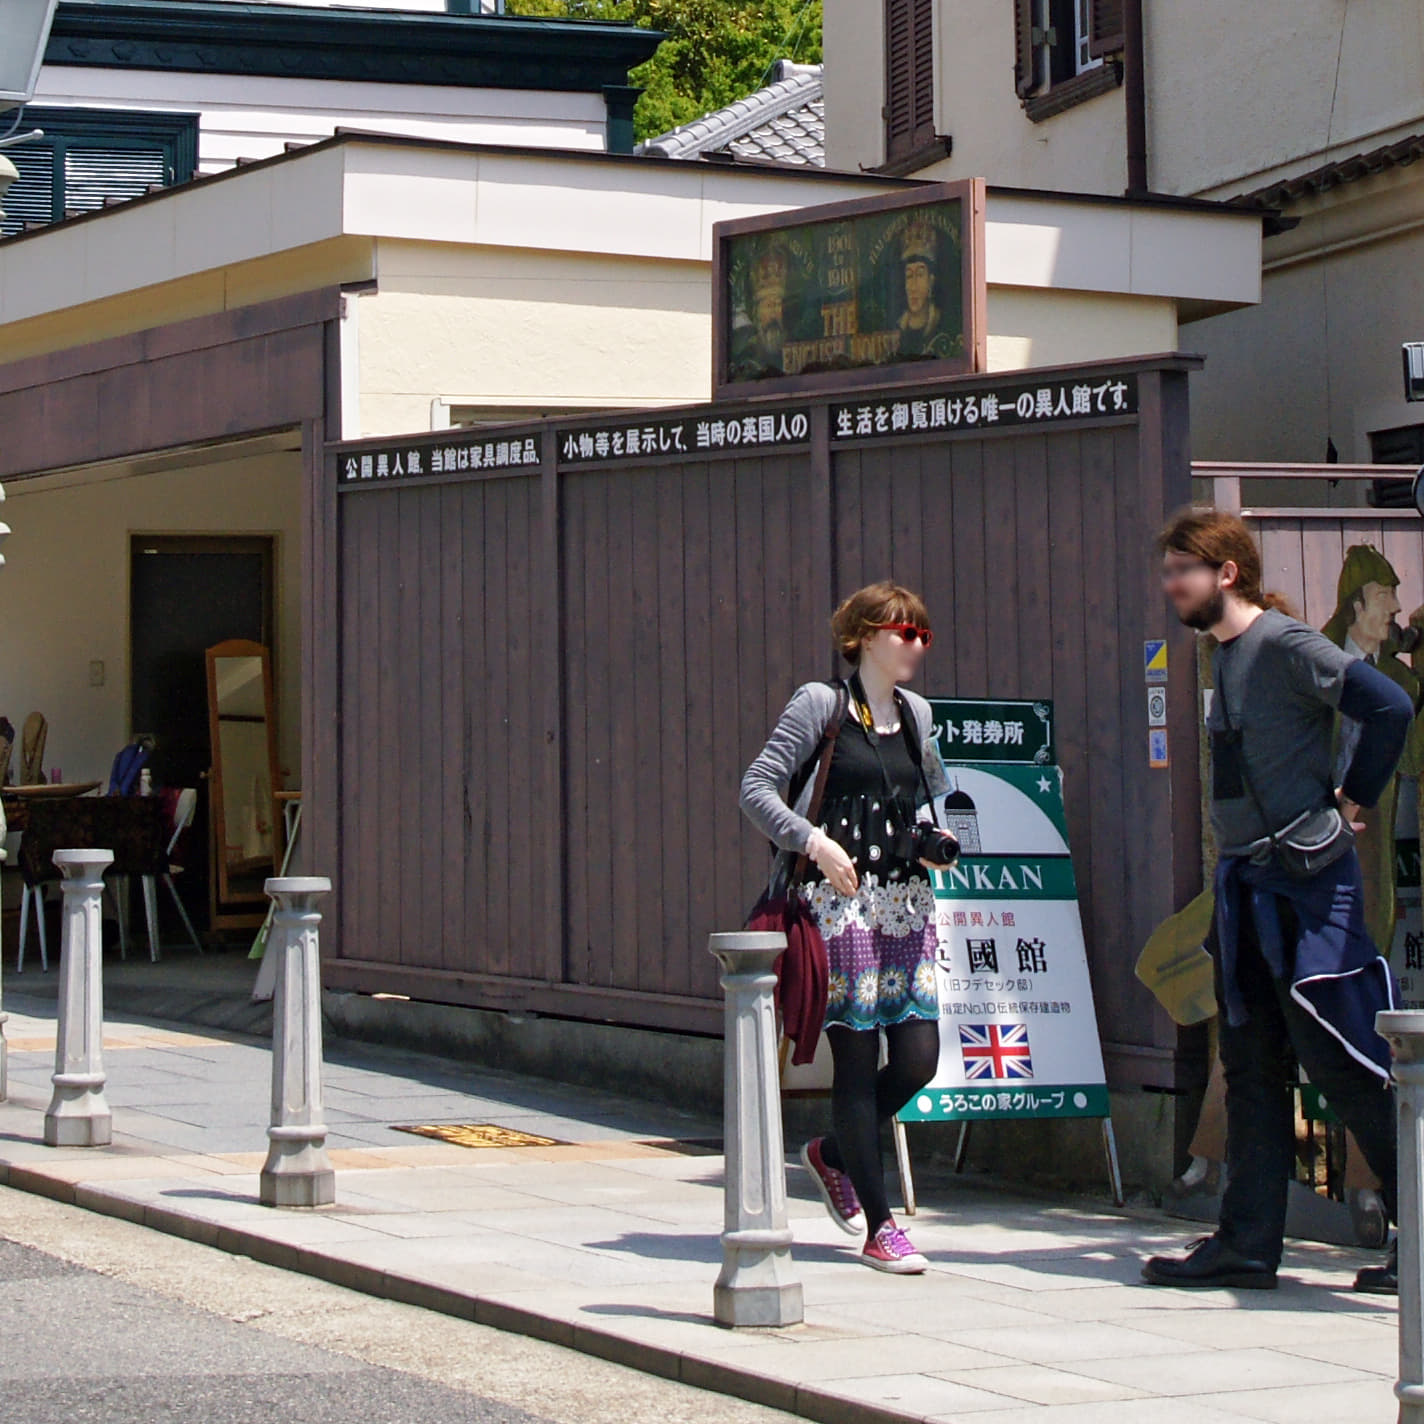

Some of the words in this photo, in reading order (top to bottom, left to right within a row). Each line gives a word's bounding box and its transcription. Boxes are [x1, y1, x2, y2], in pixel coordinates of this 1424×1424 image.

[938, 911, 1016, 927] 公開異人館
[939, 1091, 1065, 1113] うろこの家グループ
